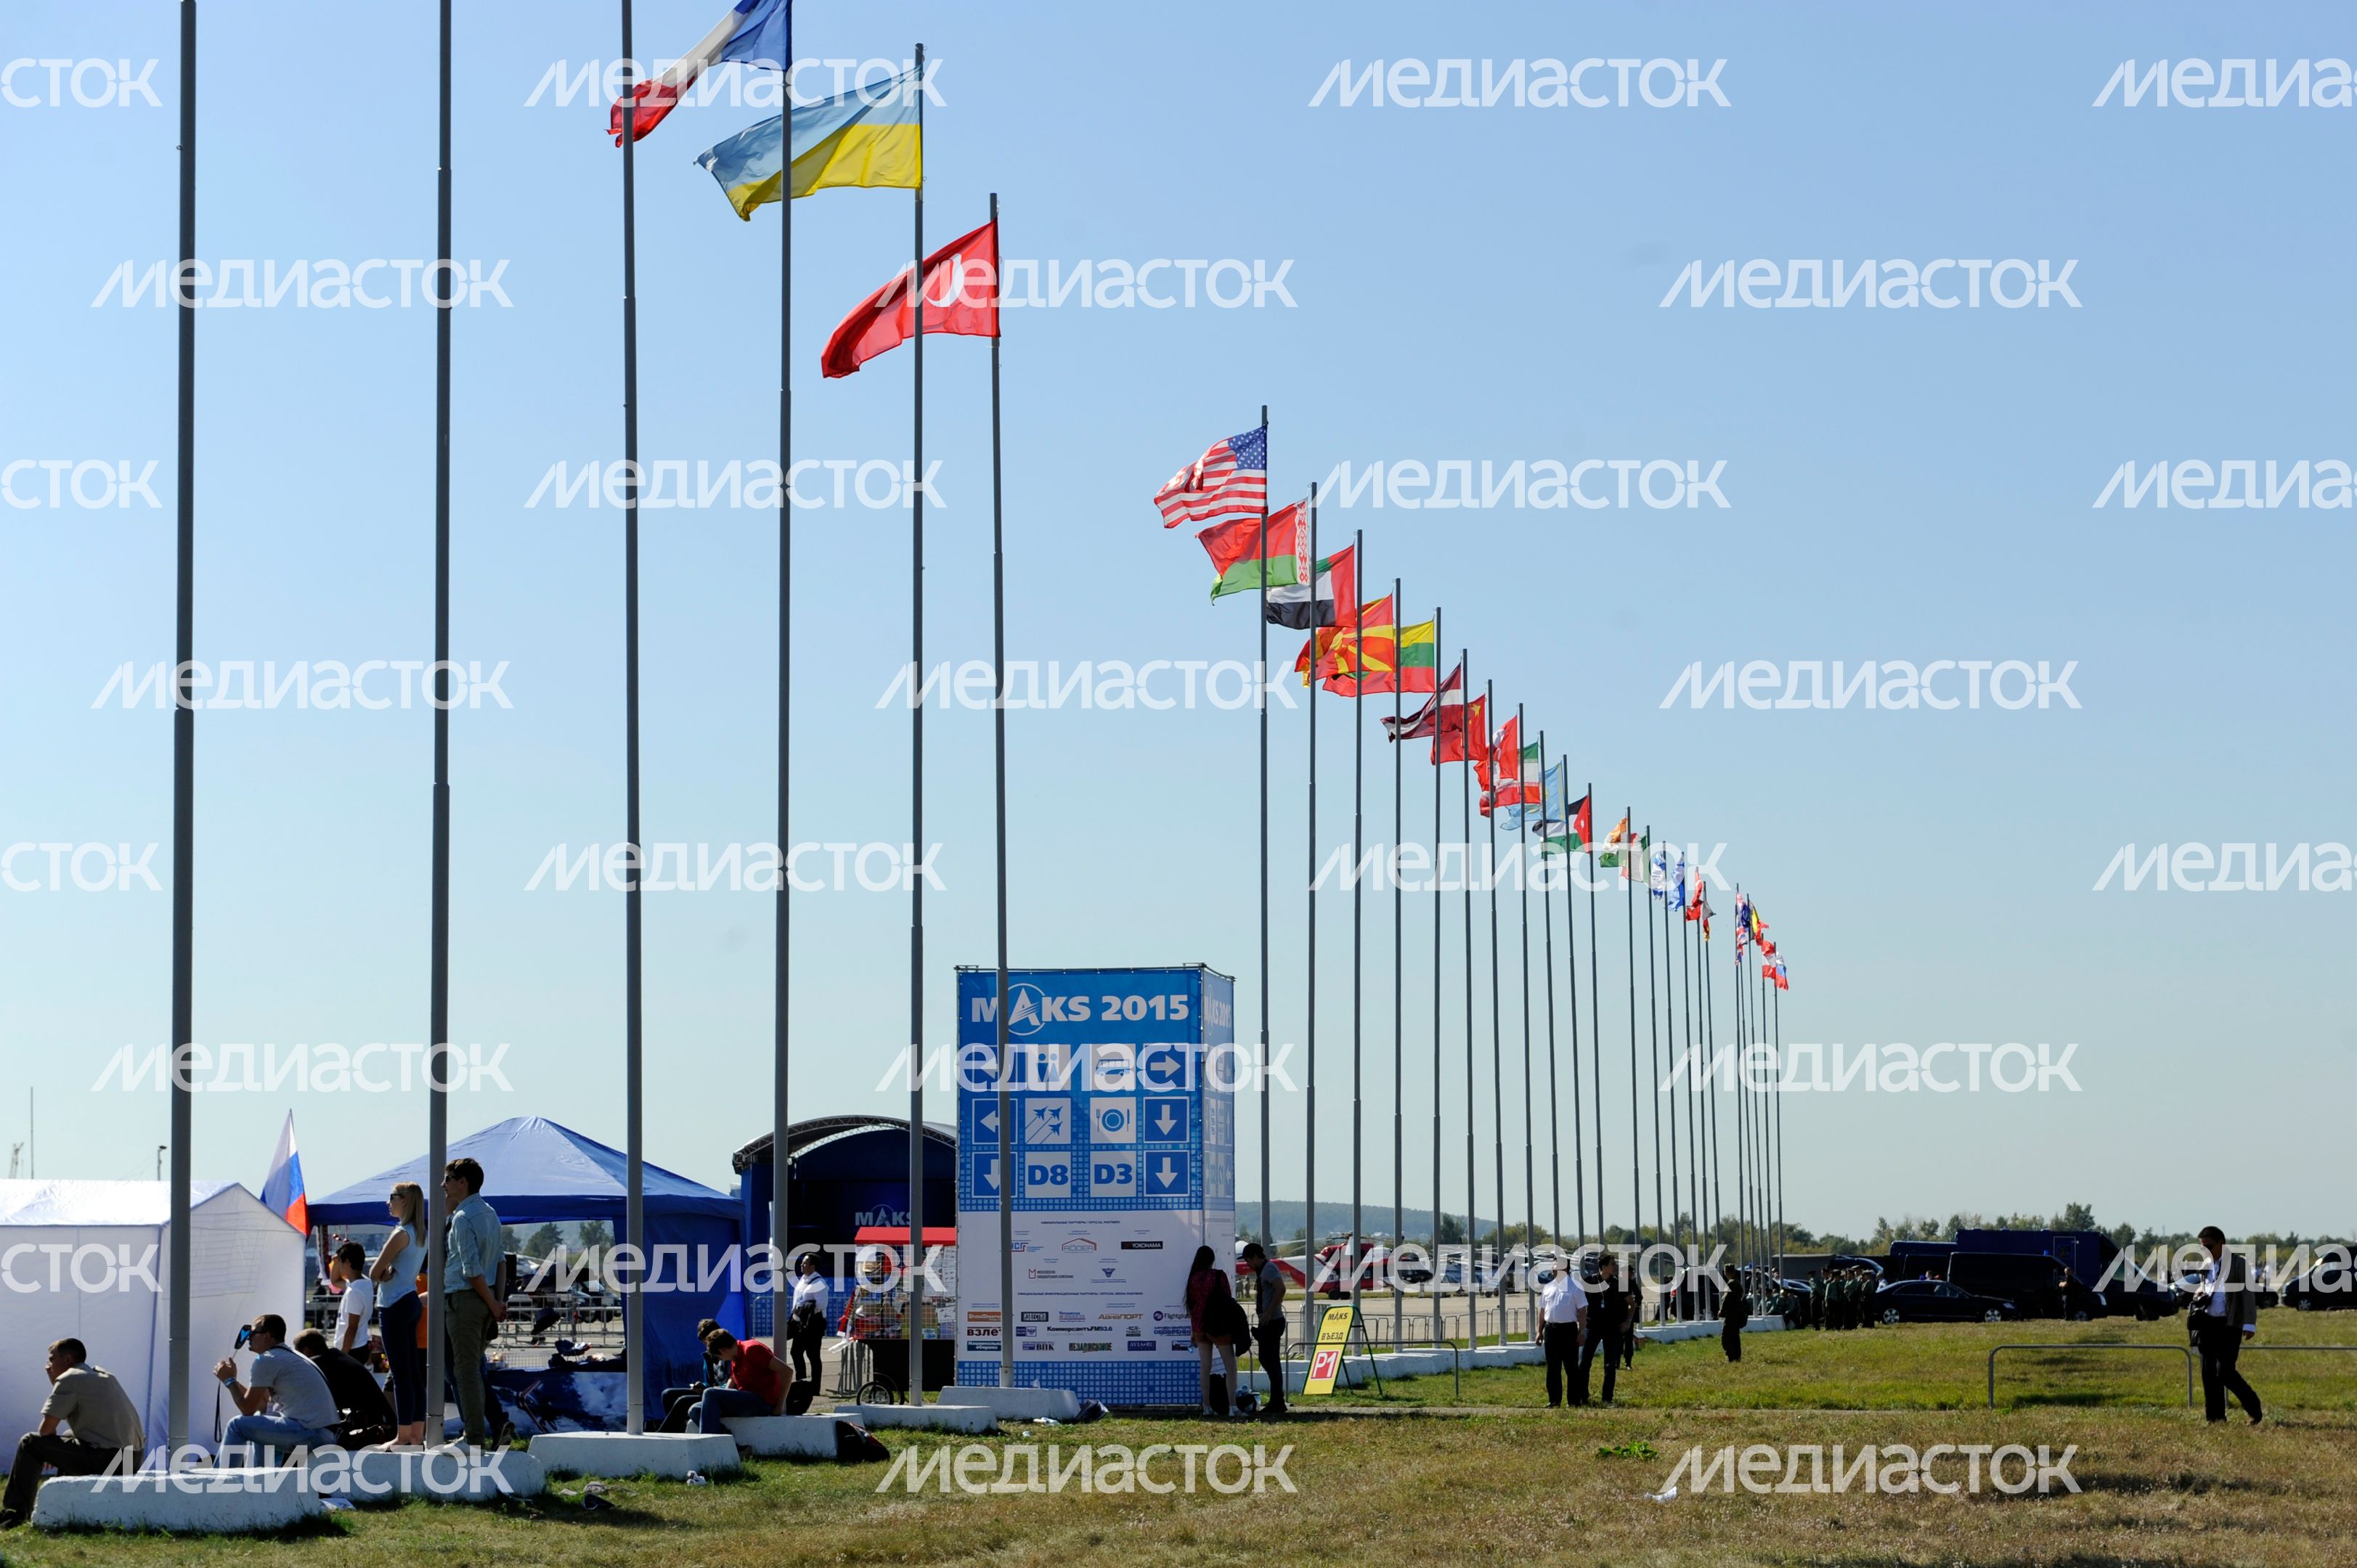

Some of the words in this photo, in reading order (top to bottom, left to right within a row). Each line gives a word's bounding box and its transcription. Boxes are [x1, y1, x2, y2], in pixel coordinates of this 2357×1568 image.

[972, 987, 1091, 1026] MAKS
[1102, 995, 1189, 1021] 2015
[1027, 1164, 1069, 1185] D8
[1094, 1164, 1133, 1185] D3
[855, 1207, 911, 1227] MAK
[1327, 1311, 1348, 1320] MAKS
[967, 1327, 1001, 1336] взлё
[1322, 1332, 1343, 1341] ВЪЕЗД
[1311, 1352, 1338, 1378] P1
